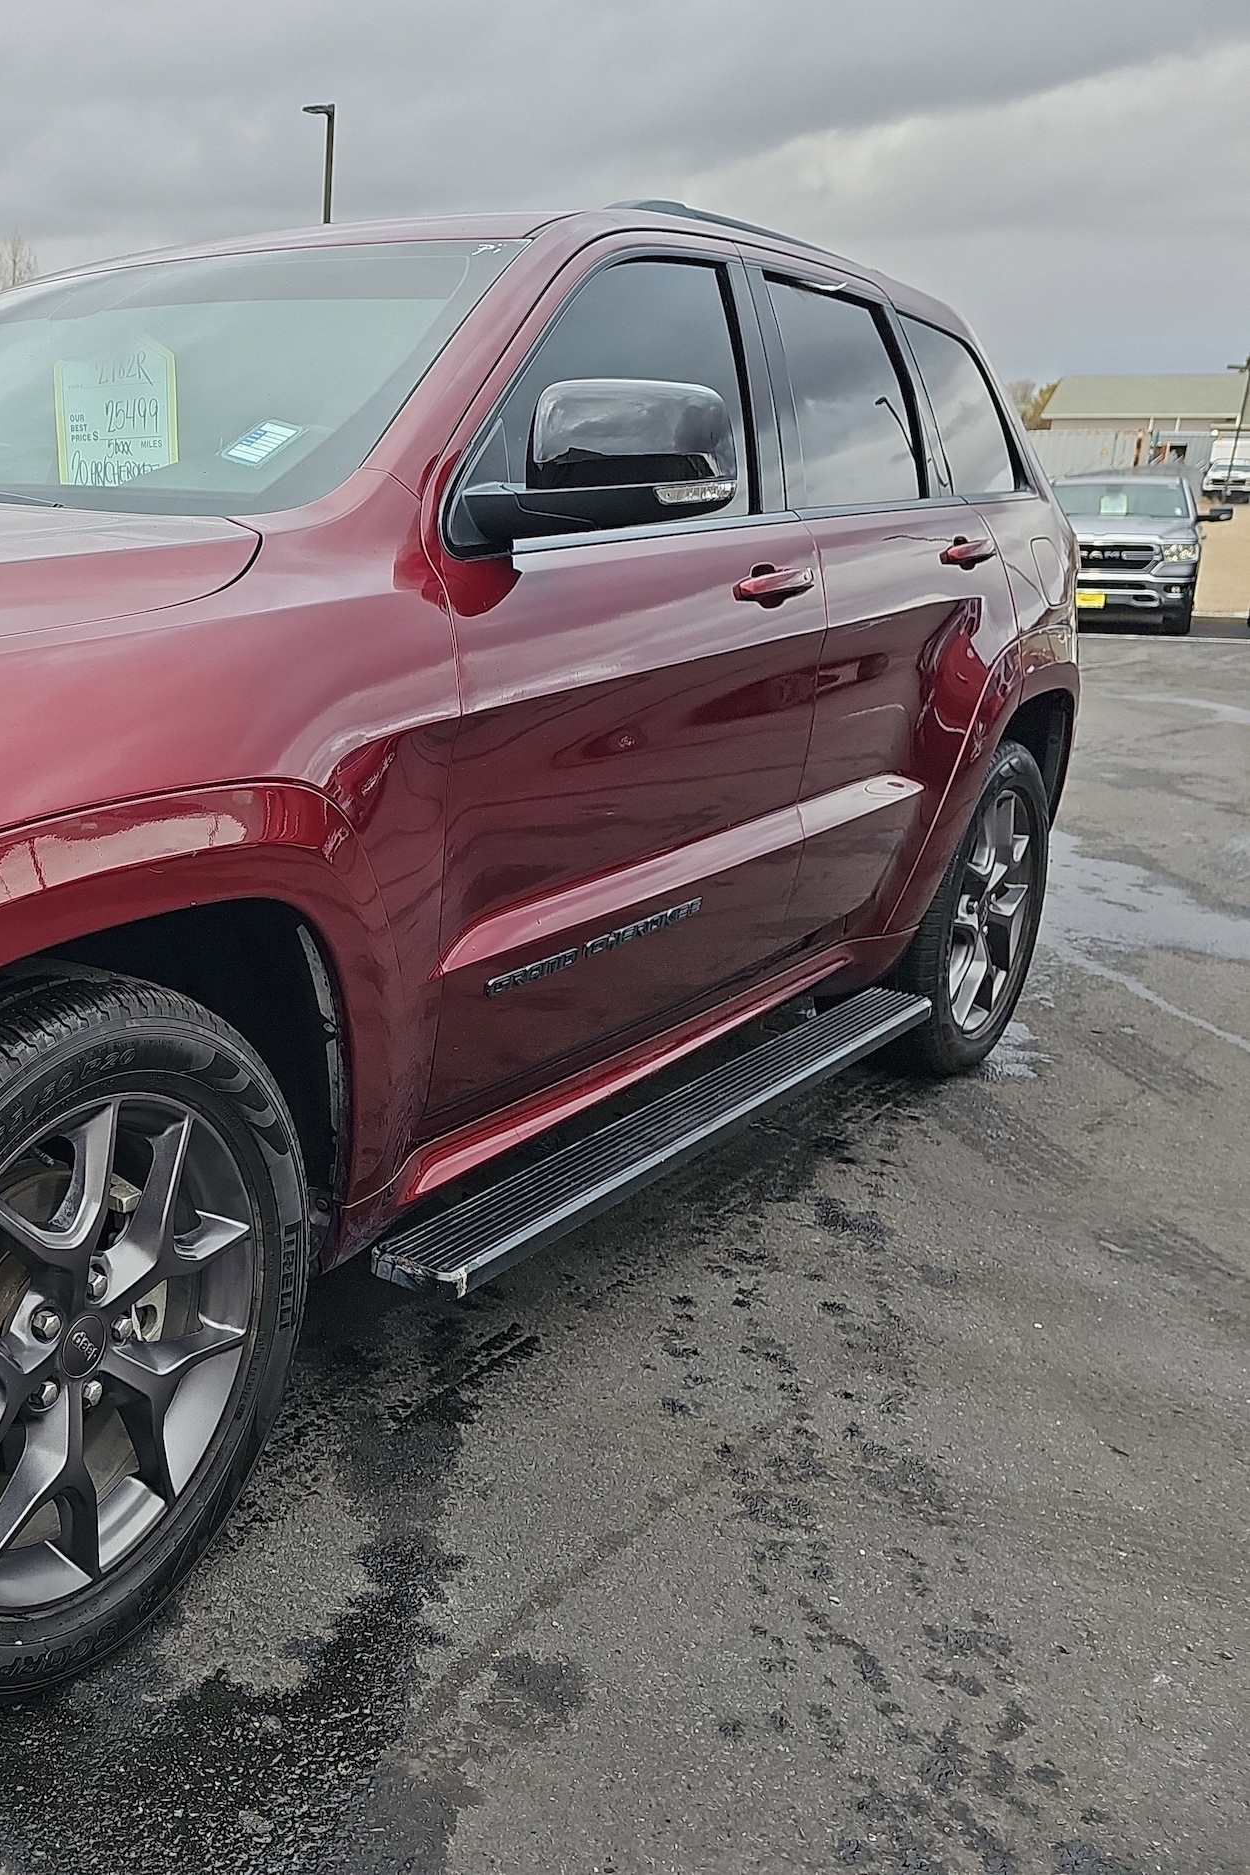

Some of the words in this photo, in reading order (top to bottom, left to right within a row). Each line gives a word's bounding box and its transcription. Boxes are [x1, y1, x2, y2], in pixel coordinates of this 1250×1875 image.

[69, 413, 85, 422] OUR
[70, 423, 88, 432] BEST
[71, 433, 92, 442] PRICE
[92, 430, 100, 442] $
[104, 396, 159, 434] 25499
[140, 439, 163, 449] MILES
[1080, 550, 1121, 560] RAM
[484, 947, 579, 997] GRAND
[582, 896, 703, 958] CHEROKEE
[278, 1218, 304, 1334] PIRELLI
[71, 1330, 99, 1362] Jeep
